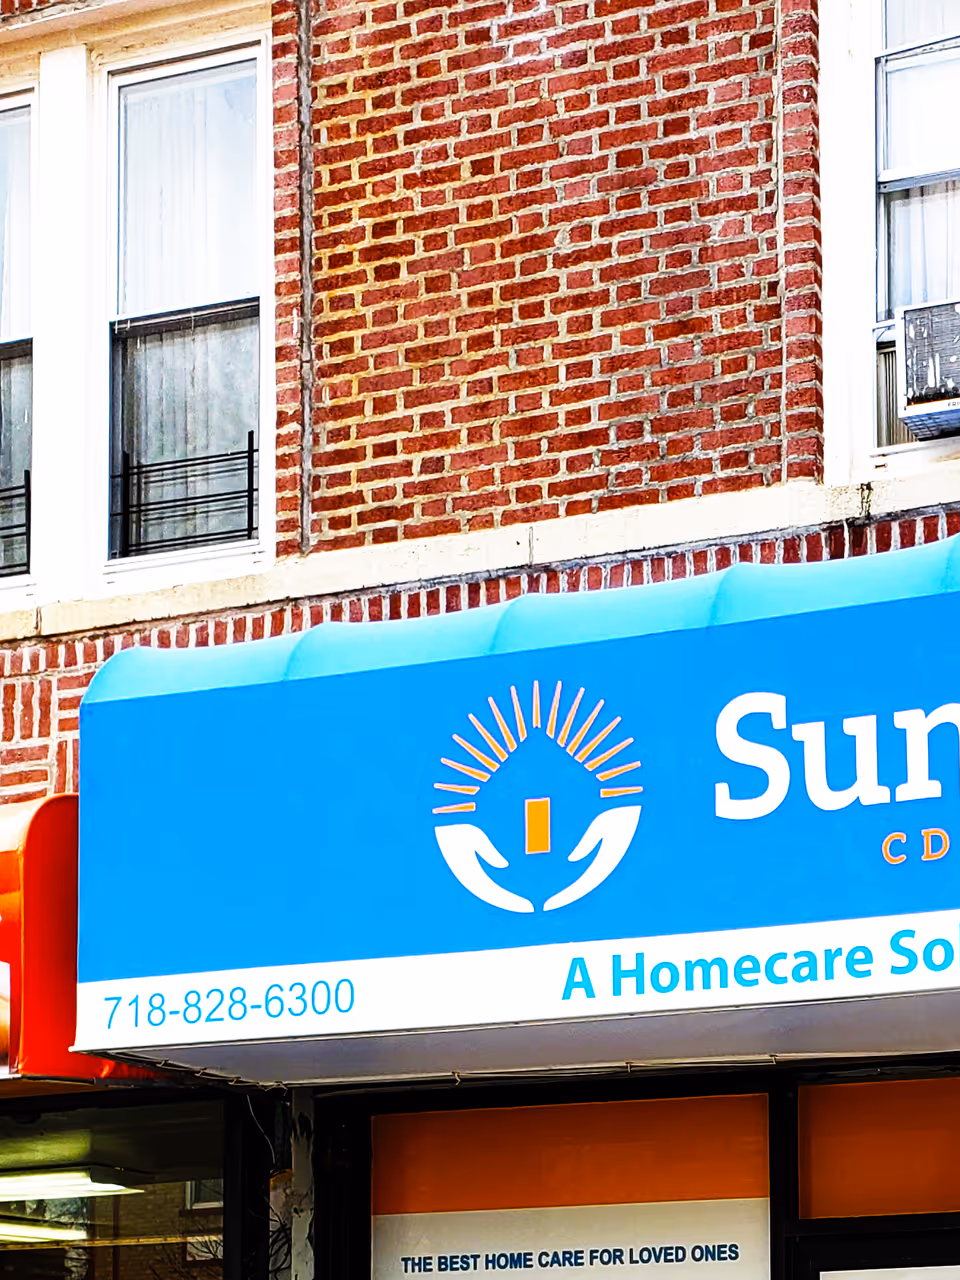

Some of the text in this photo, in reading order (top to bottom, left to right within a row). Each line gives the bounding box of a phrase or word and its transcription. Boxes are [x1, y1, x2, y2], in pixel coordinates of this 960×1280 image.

[562, 957, 596, 1000] A
[612, 946, 873, 996] Homecare
[104, 979, 354, 1029] 718-828-6300
[401, 1244, 739, 1273] THE BEST HOME CARE FOR LOVED ONES
